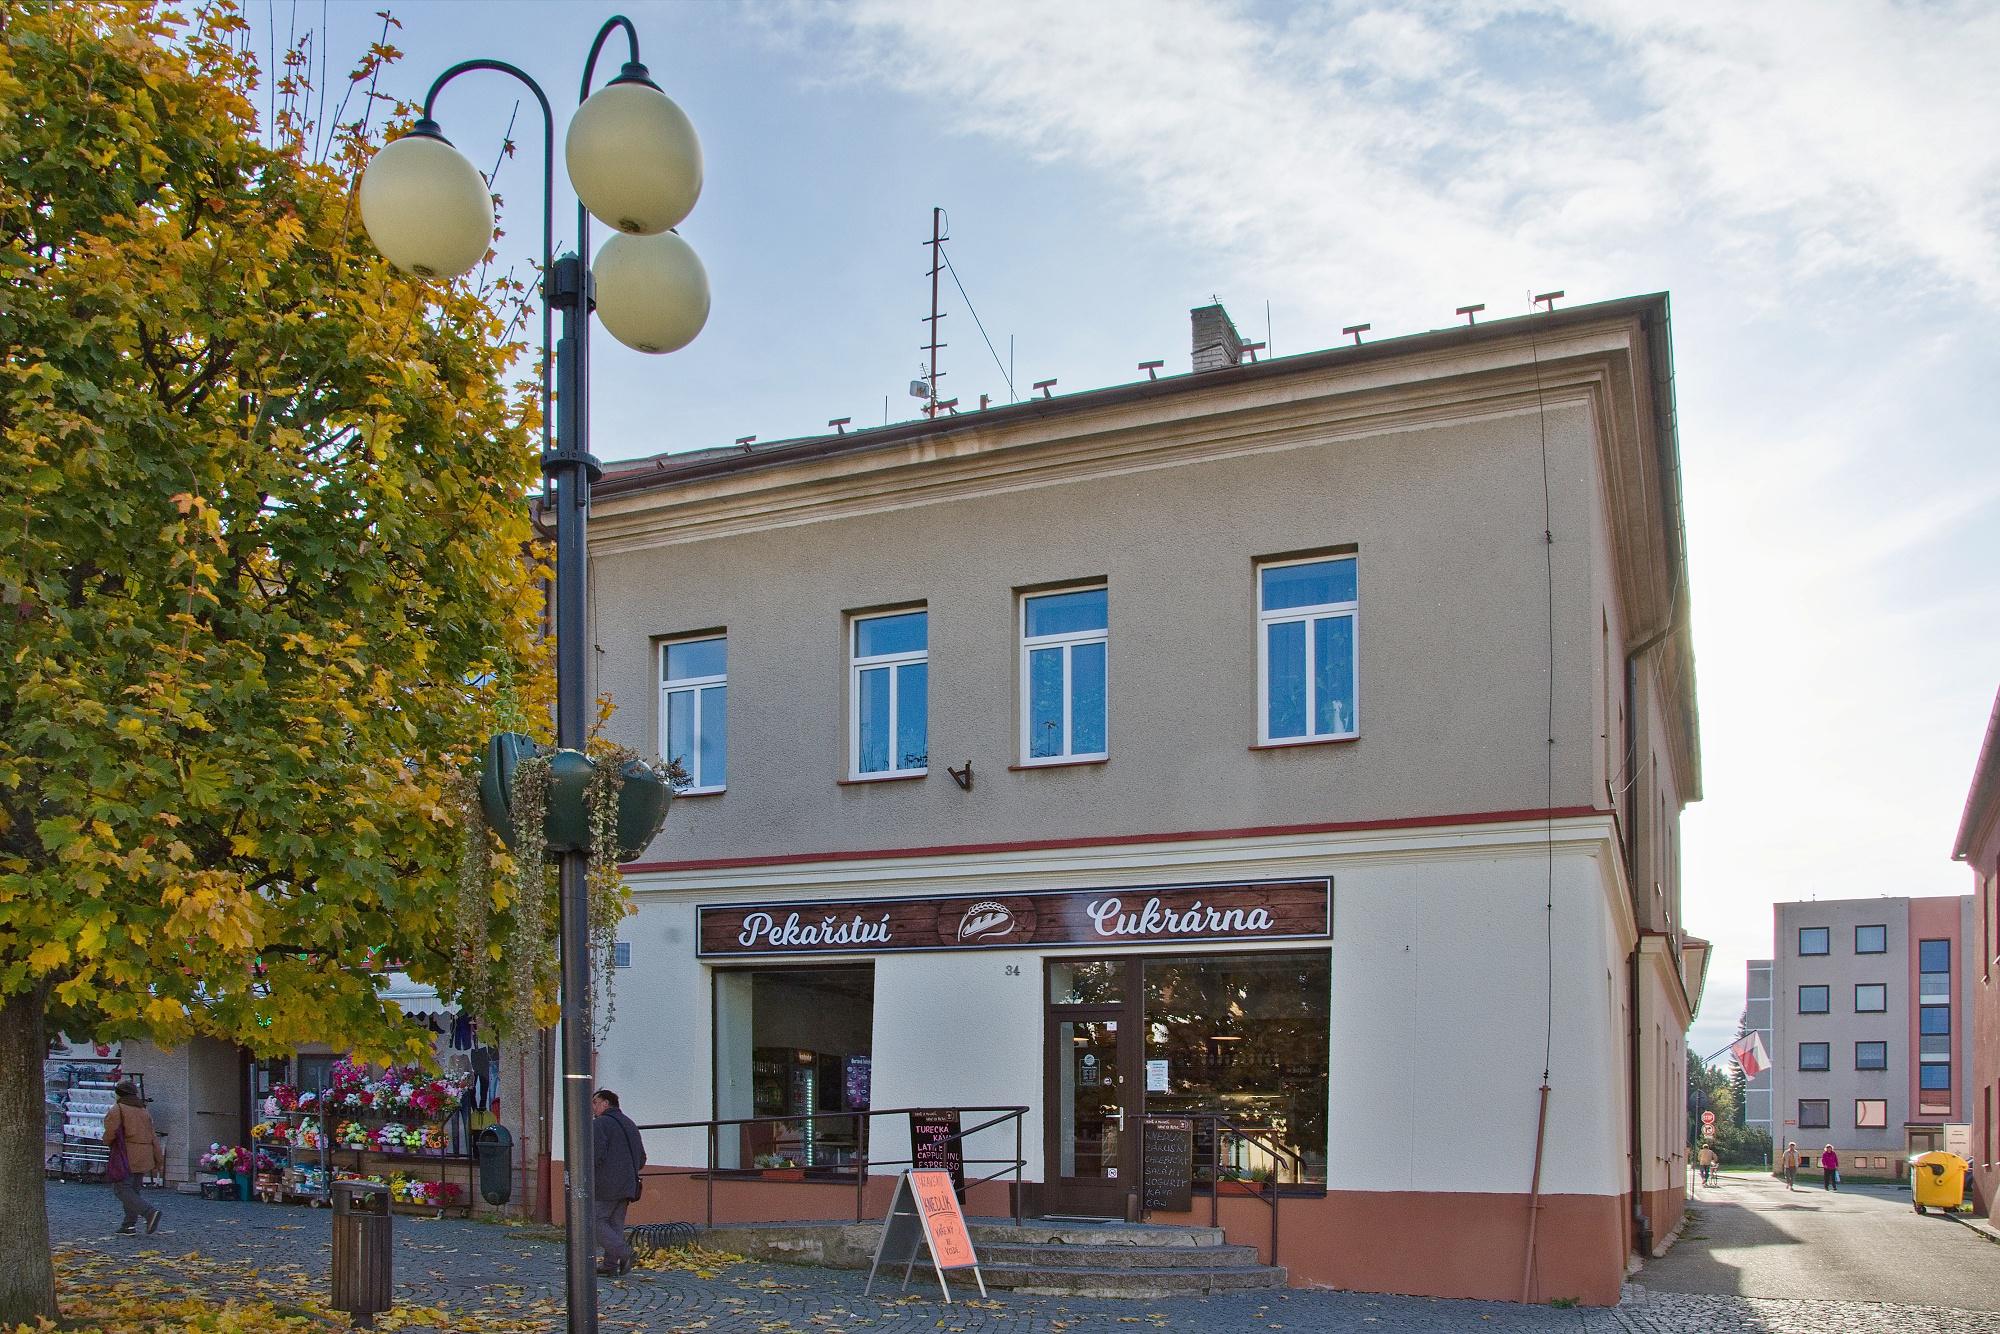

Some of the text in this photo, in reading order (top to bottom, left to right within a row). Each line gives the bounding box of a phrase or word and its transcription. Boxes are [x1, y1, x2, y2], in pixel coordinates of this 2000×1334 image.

[738, 897, 1274, 947] Pekařství Cukrárna
[1004, 965, 1021, 976] 34
[916, 1123, 949, 1133] TURECKÁ
